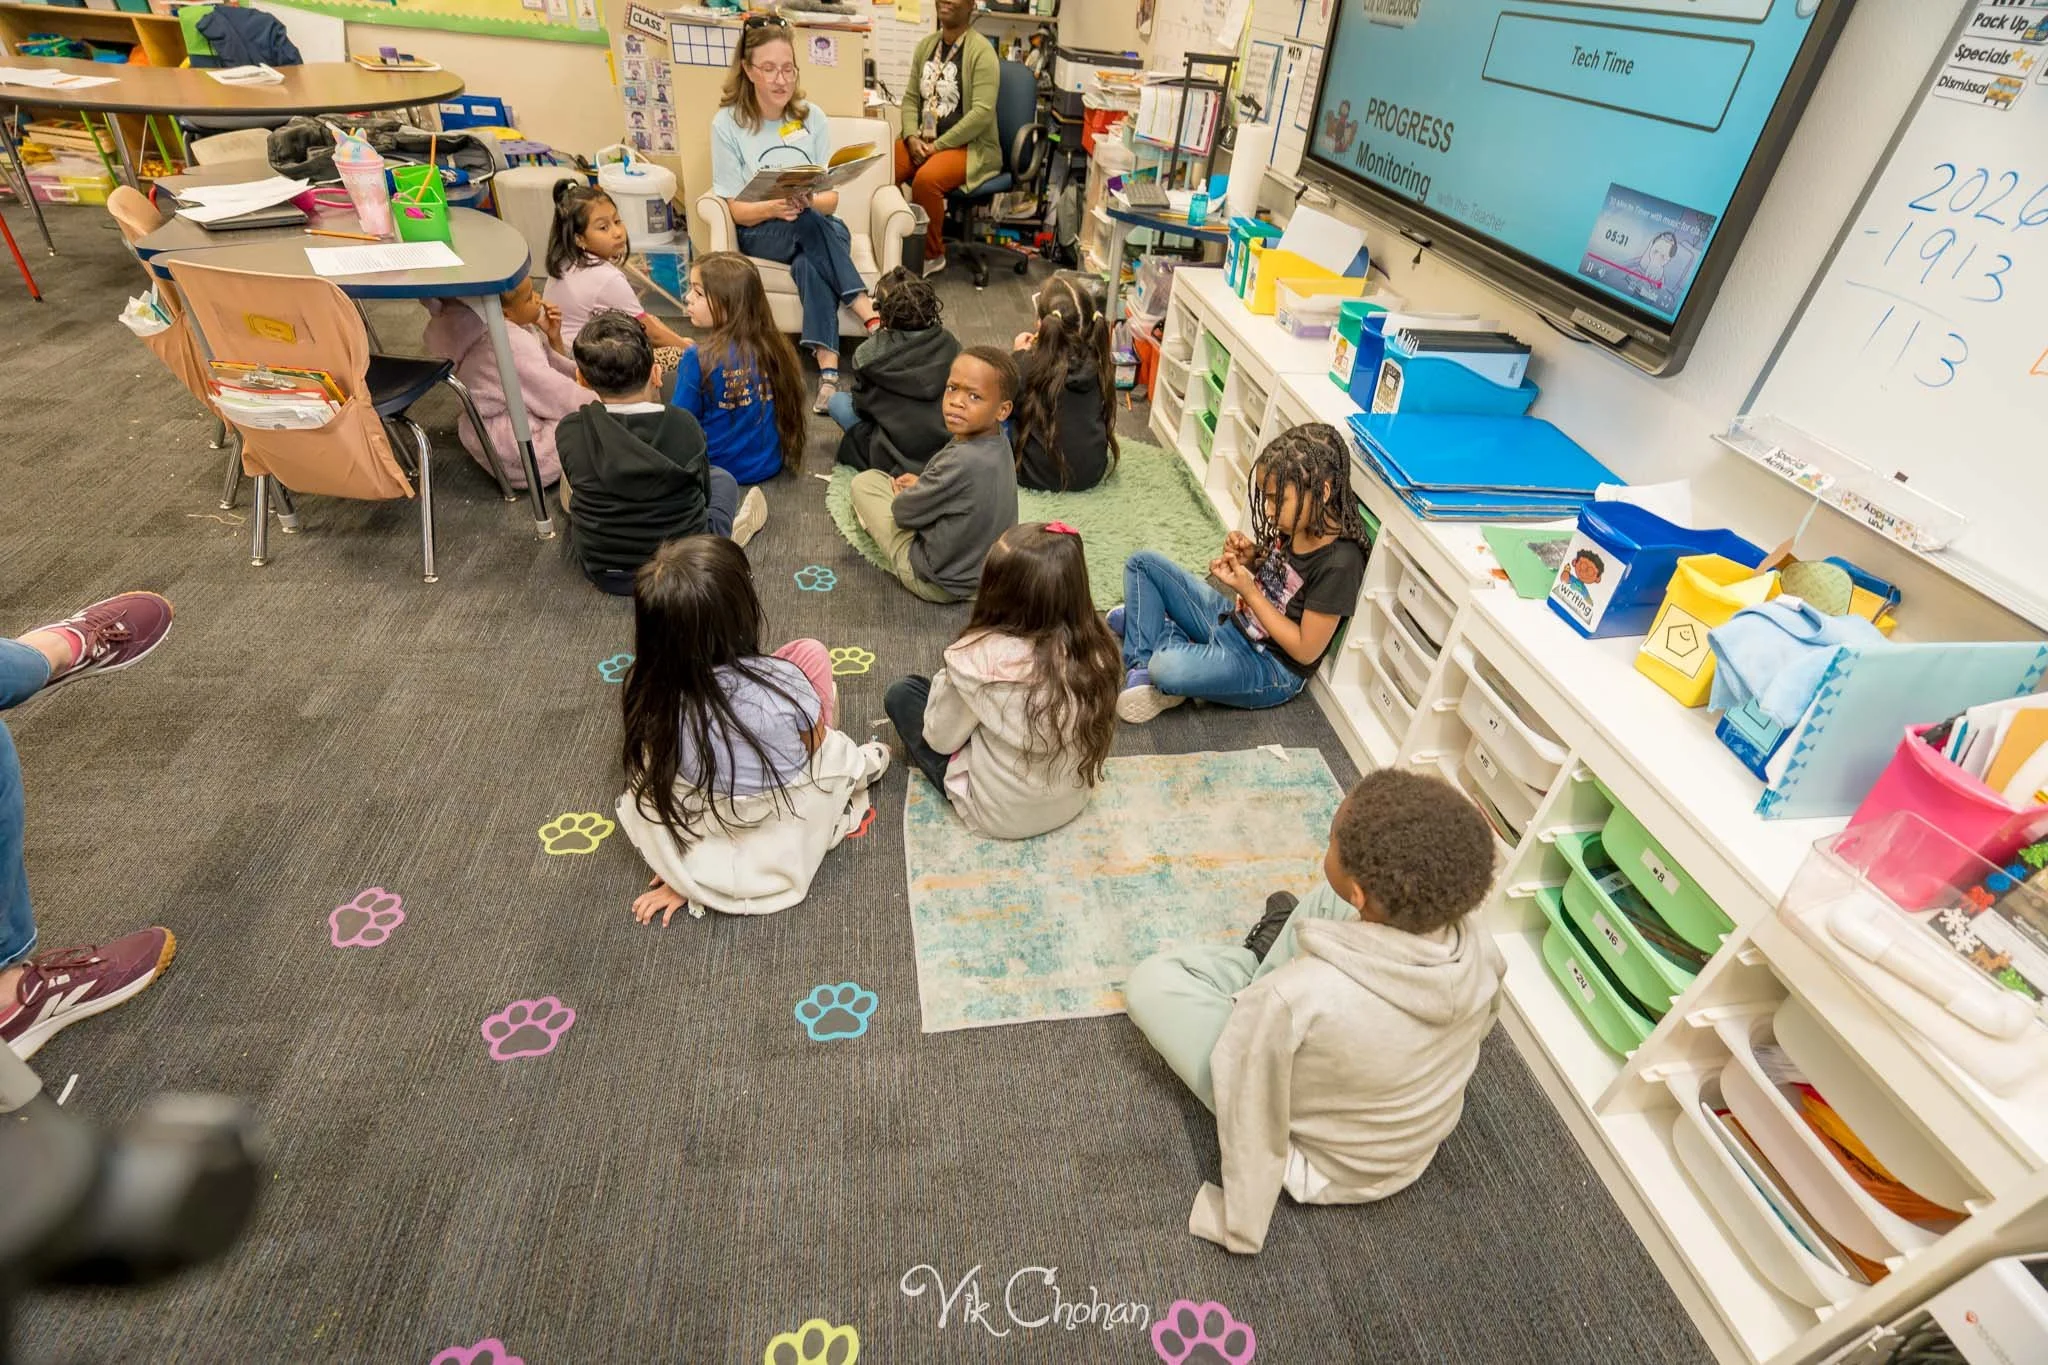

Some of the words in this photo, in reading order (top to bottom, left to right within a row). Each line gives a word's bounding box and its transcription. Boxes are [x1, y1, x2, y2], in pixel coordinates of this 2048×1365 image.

[632, 12, 661, 32] CLASS
[1972, 12, 2009, 29] Pack
[2009, 15, 2029, 34] Up
[1288, 46, 1302, 61] MATH
[1571, 46, 1599, 68] Tech
[1603, 51, 1634, 75] Time
[1954, 43, 2011, 65] Specials
[1937, 75, 1989, 95] Dismissal
[1365, 97, 1454, 153] PROGRESS
[1355, 140, 1431, 204] Monitoring
[1907, 162, 2048, 232] 2026
[1470, 203, 1506, 231] Teacher
[1605, 229, 1629, 247] 05:31
[1764, 456, 1796, 478] Activity
[1774, 450, 1807, 470] Special
[1863, 502, 1895, 527] Friday
[1560, 584, 1592, 617] writing
[1653, 866, 1666, 883] #8
[1604, 927, 1619, 946] #16
[1573, 967, 1588, 990] #24
